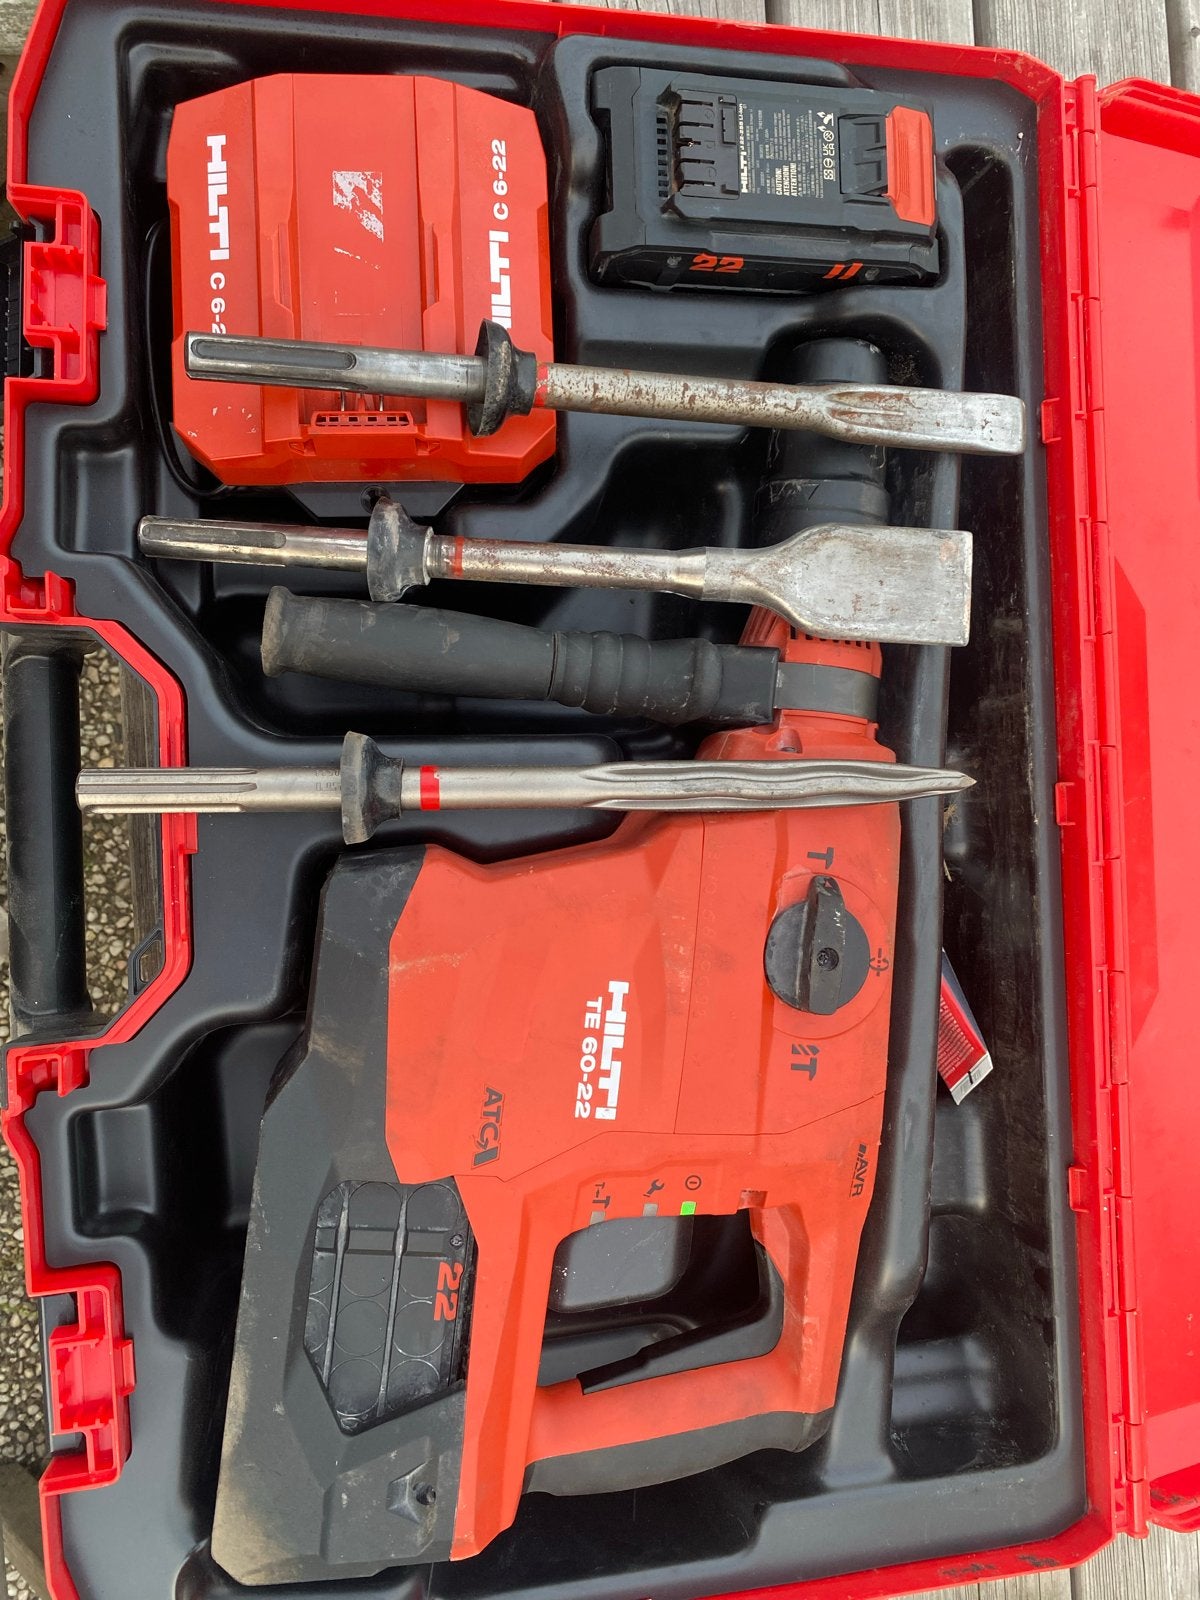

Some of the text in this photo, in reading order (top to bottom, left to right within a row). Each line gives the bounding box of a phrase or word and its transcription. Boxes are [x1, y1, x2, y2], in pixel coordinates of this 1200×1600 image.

[491, 139, 508, 195] 6-22
[740, 151, 748, 193] HILTI
[775, 167, 783, 196] CAUTION!
[206, 134, 230, 260] HILTI
[493, 202, 509, 221] C
[210, 272, 225, 290] C
[689, 253, 744, 274] 22
[574, 996, 603, 1119] TE 60-22
[594, 980, 630, 1120] HILTI
[479, 1087, 503, 1142] ATC
[852, 1158, 868, 1197] AVR
[433, 1262, 463, 1321] 22
